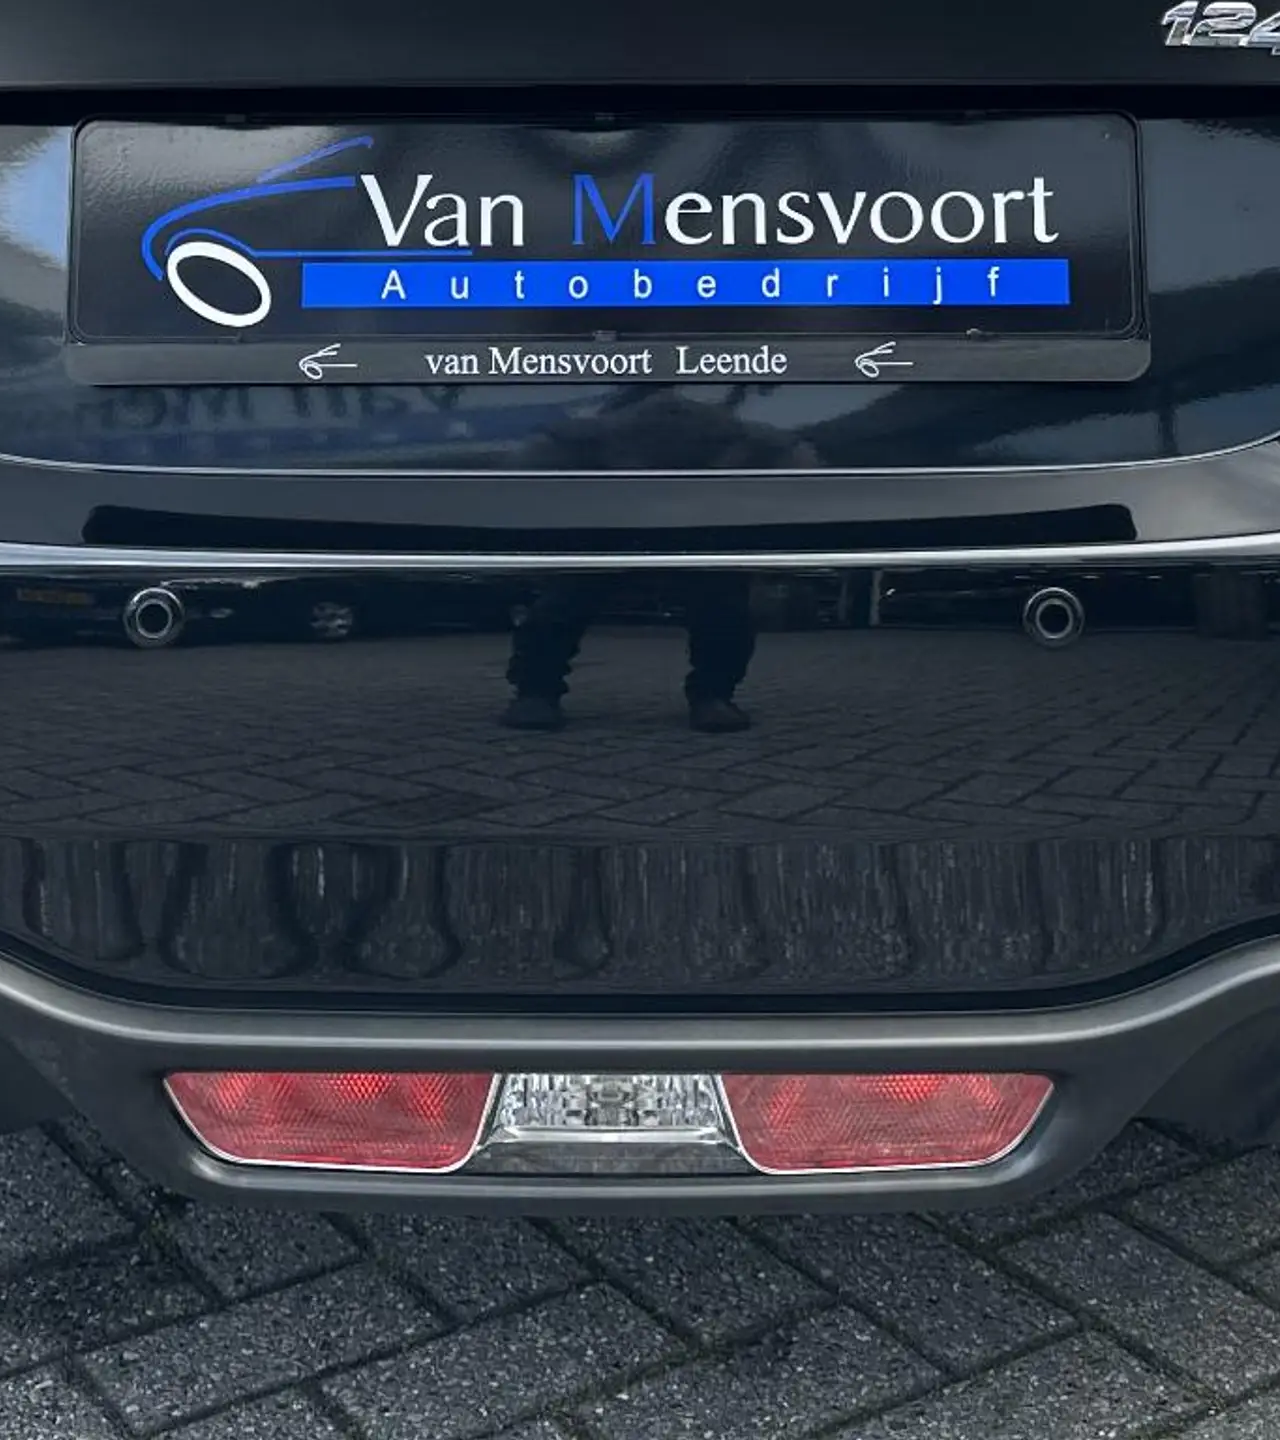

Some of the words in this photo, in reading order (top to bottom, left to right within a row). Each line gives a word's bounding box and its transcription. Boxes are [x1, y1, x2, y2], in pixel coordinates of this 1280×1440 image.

[360, 174, 524, 247] Van
[571, 172, 1060, 246] Mensvoort
[380, 266, 1001, 305] Autobedrijf
[424, 353, 480, 375] van
[487, 346, 653, 375] Mensvoort
[674, 345, 788, 375] Leende
